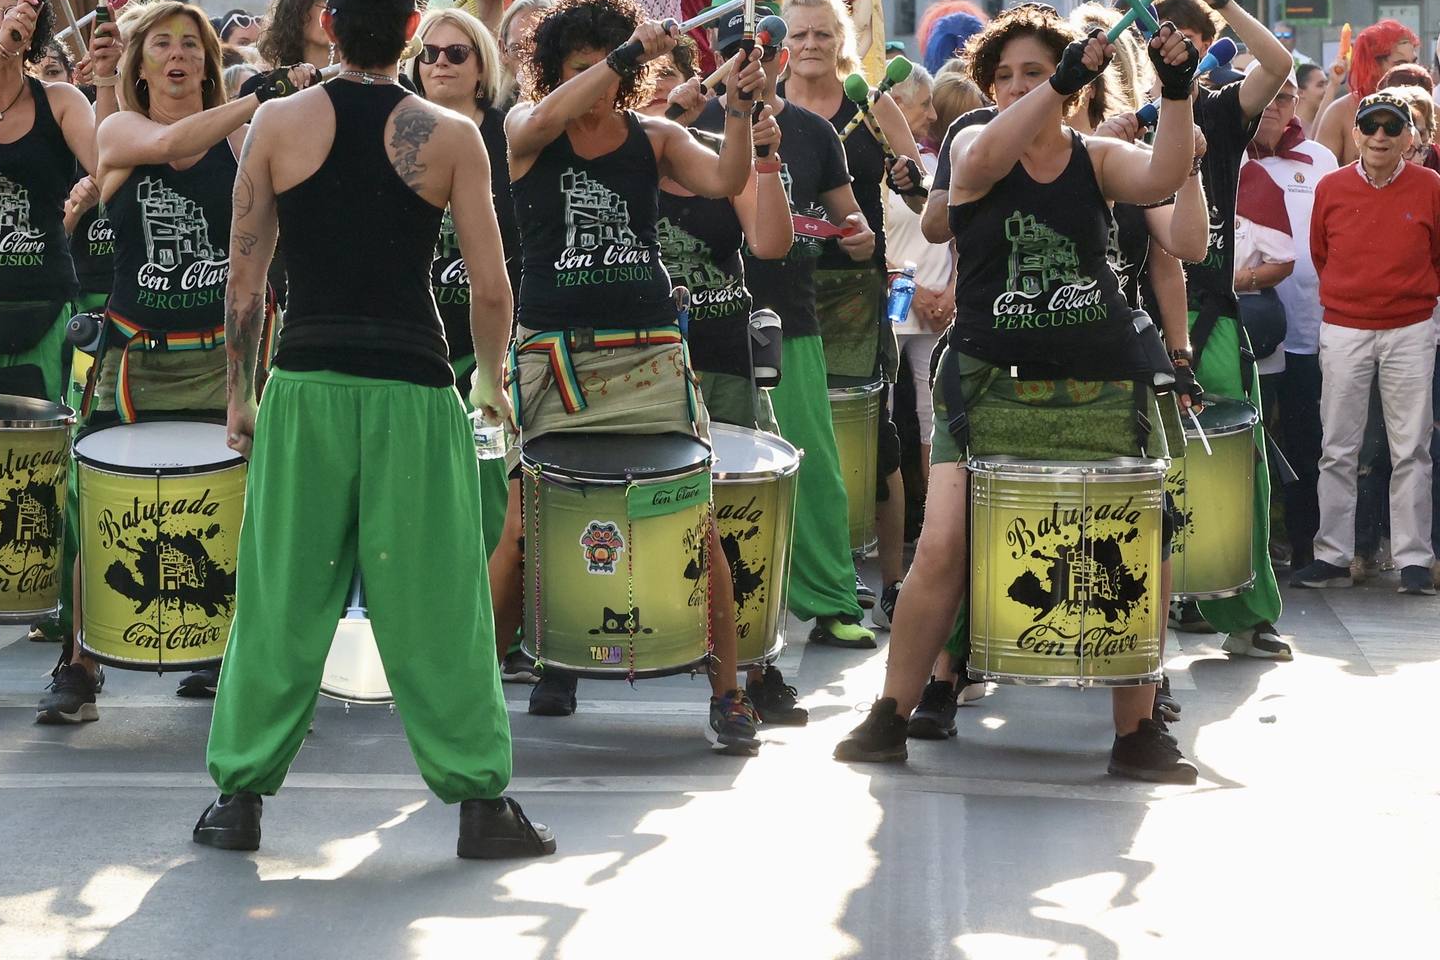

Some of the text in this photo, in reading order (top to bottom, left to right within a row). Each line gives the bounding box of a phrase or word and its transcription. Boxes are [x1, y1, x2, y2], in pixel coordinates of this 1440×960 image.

[137, 258, 231, 290] Con Clav
[554, 244, 599, 271] Con
[993, 280, 1102, 316] Con Clave
[96, 489, 220, 549] Batucada
[1005, 496, 1141, 560] Batucada
[122, 622, 220, 650] Con Clave
[1016, 624, 1138, 658] Con Clave
